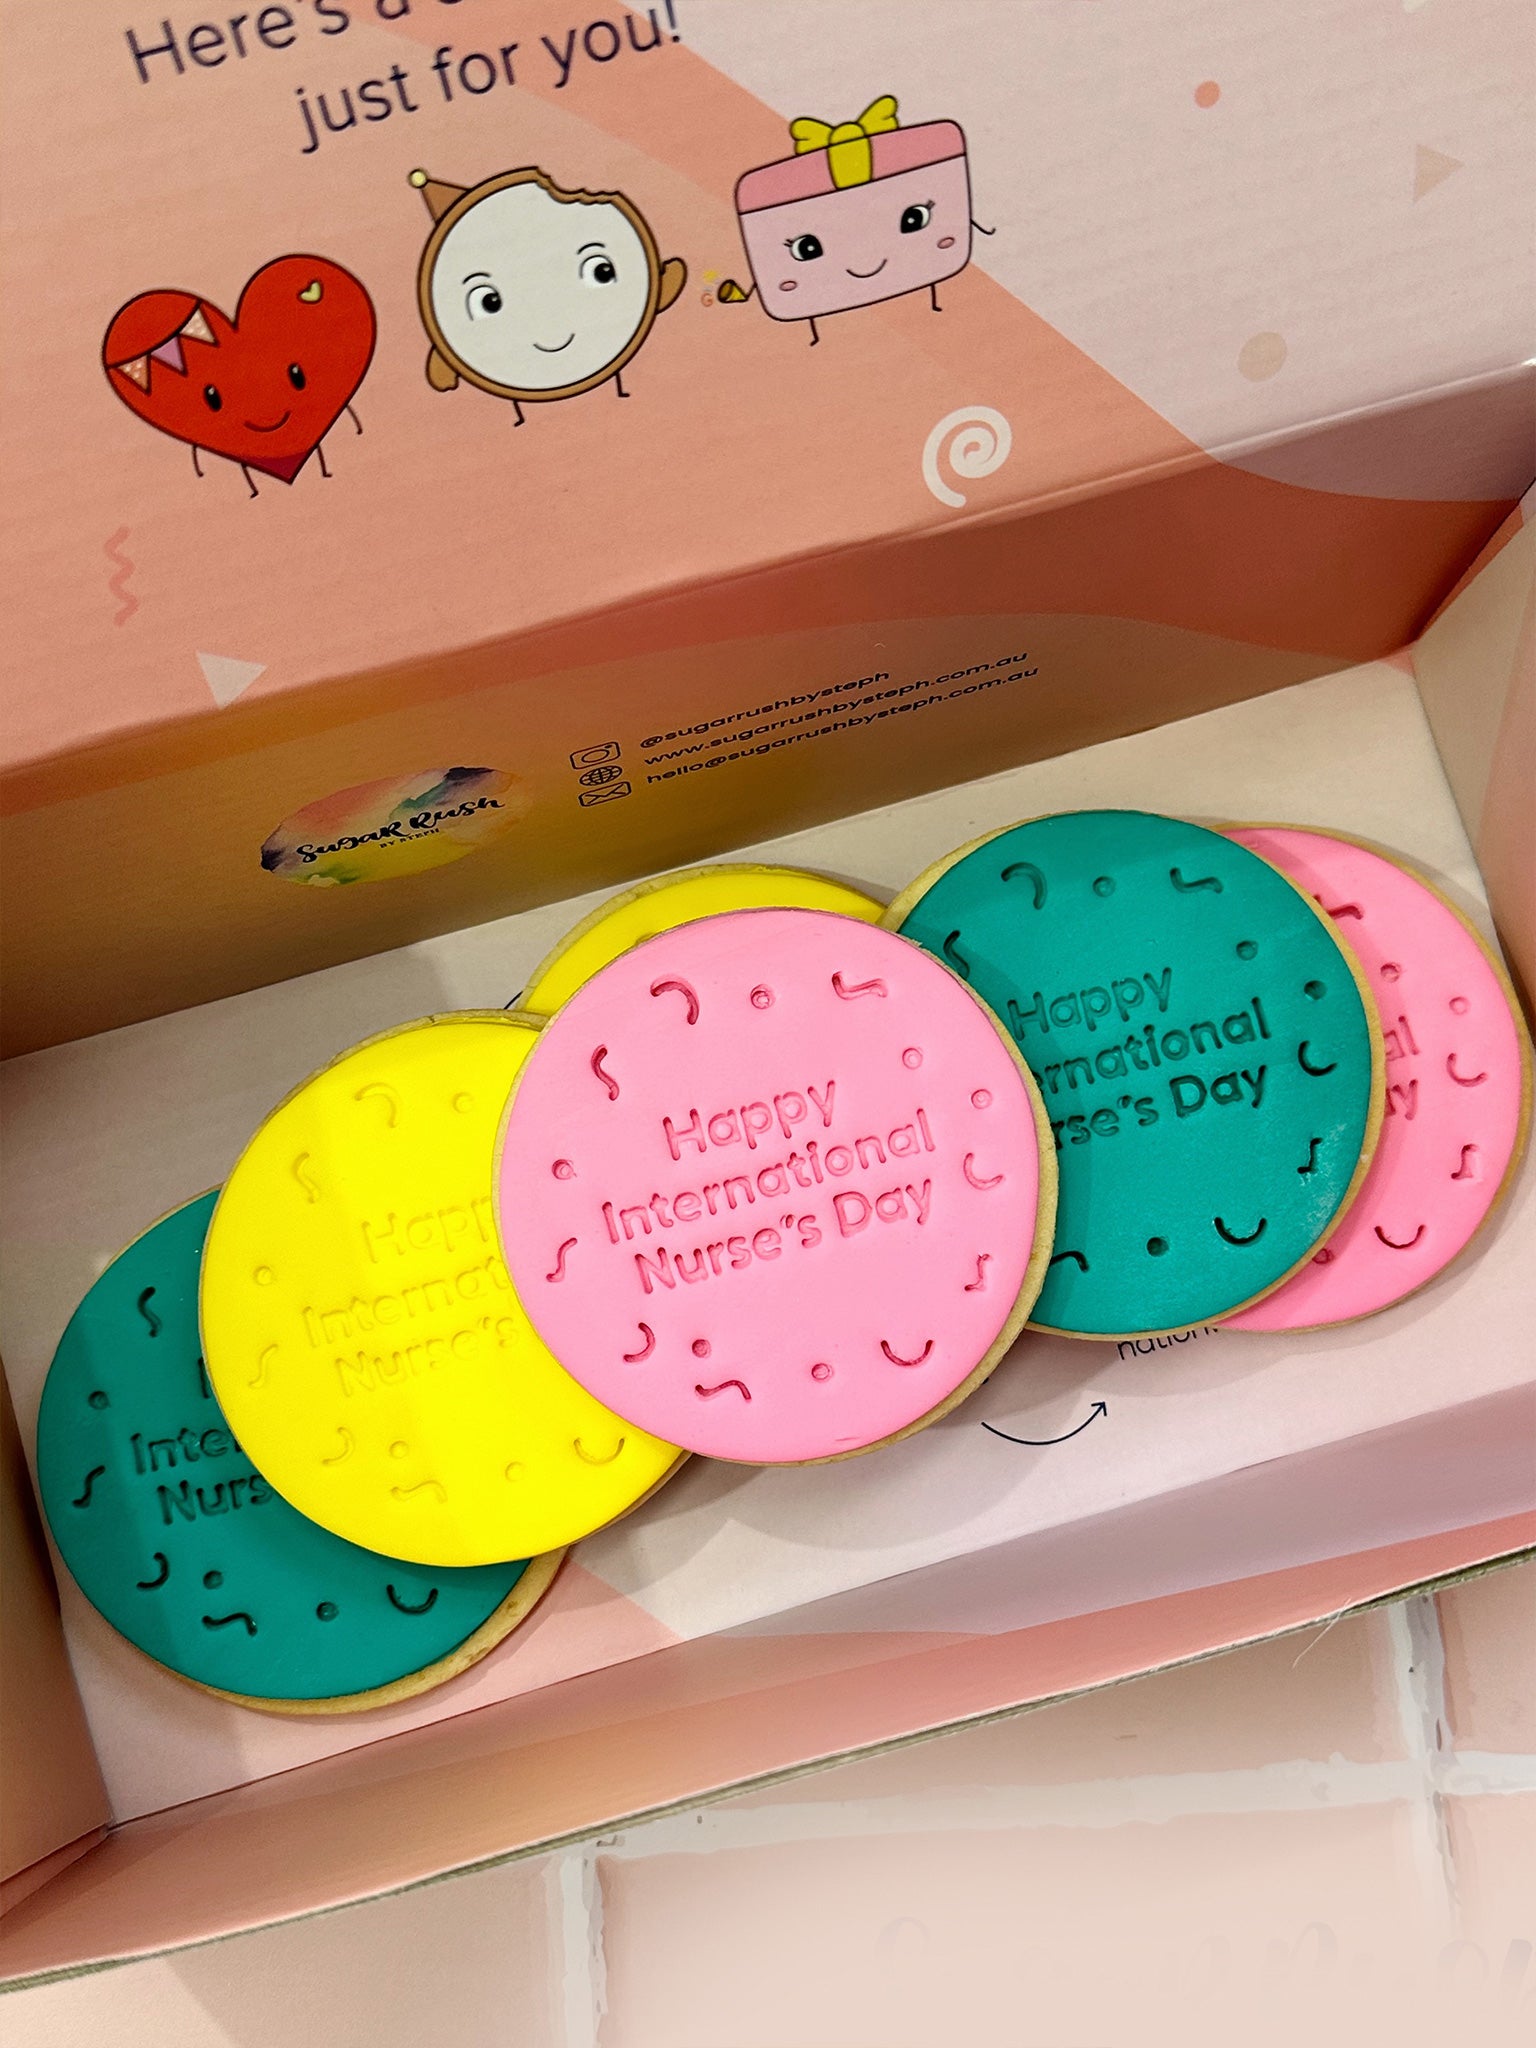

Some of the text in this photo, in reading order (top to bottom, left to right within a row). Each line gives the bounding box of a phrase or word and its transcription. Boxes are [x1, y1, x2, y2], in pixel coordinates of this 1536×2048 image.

[301, 0, 681, 154] just for you!
[640, 671, 889, 748] @sugarrushbysteph
[645, 652, 1028, 765] www.sugarrushbysteph.com.au
[647, 668, 1038, 784] hello@sugarrushbysteph.com.au
[1008, 967, 1172, 1041] Happy
[662, 1080, 835, 1161] Happy
[1169, 1065, 1267, 1119] Day
[601, 1107, 935, 1244] International
[634, 1178, 931, 1294] Nurse's Day
[334, 1315, 520, 1398] Nurse's
